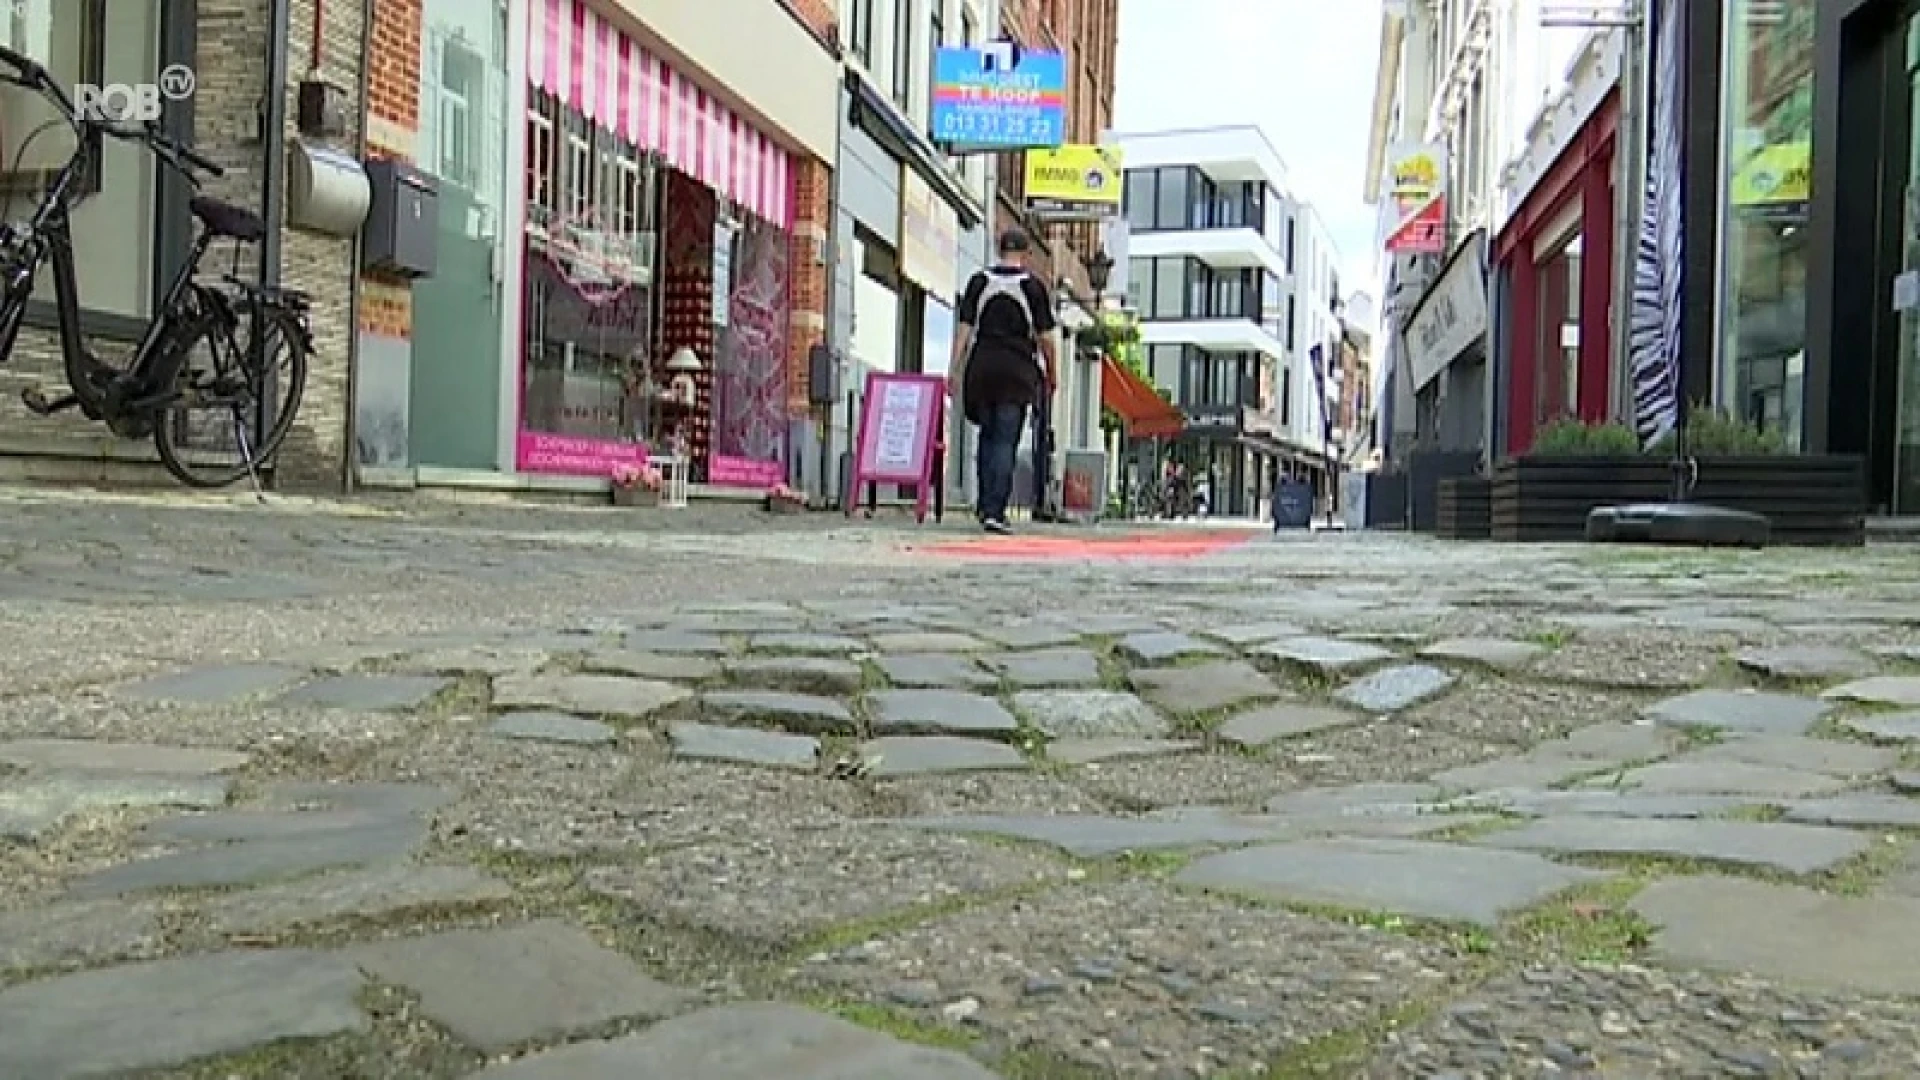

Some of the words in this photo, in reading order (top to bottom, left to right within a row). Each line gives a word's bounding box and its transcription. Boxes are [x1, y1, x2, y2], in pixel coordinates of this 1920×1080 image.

[959, 85, 983, 101] TE
[989, 87, 1041, 104] KOOP
[944, 112, 974, 130] 013
